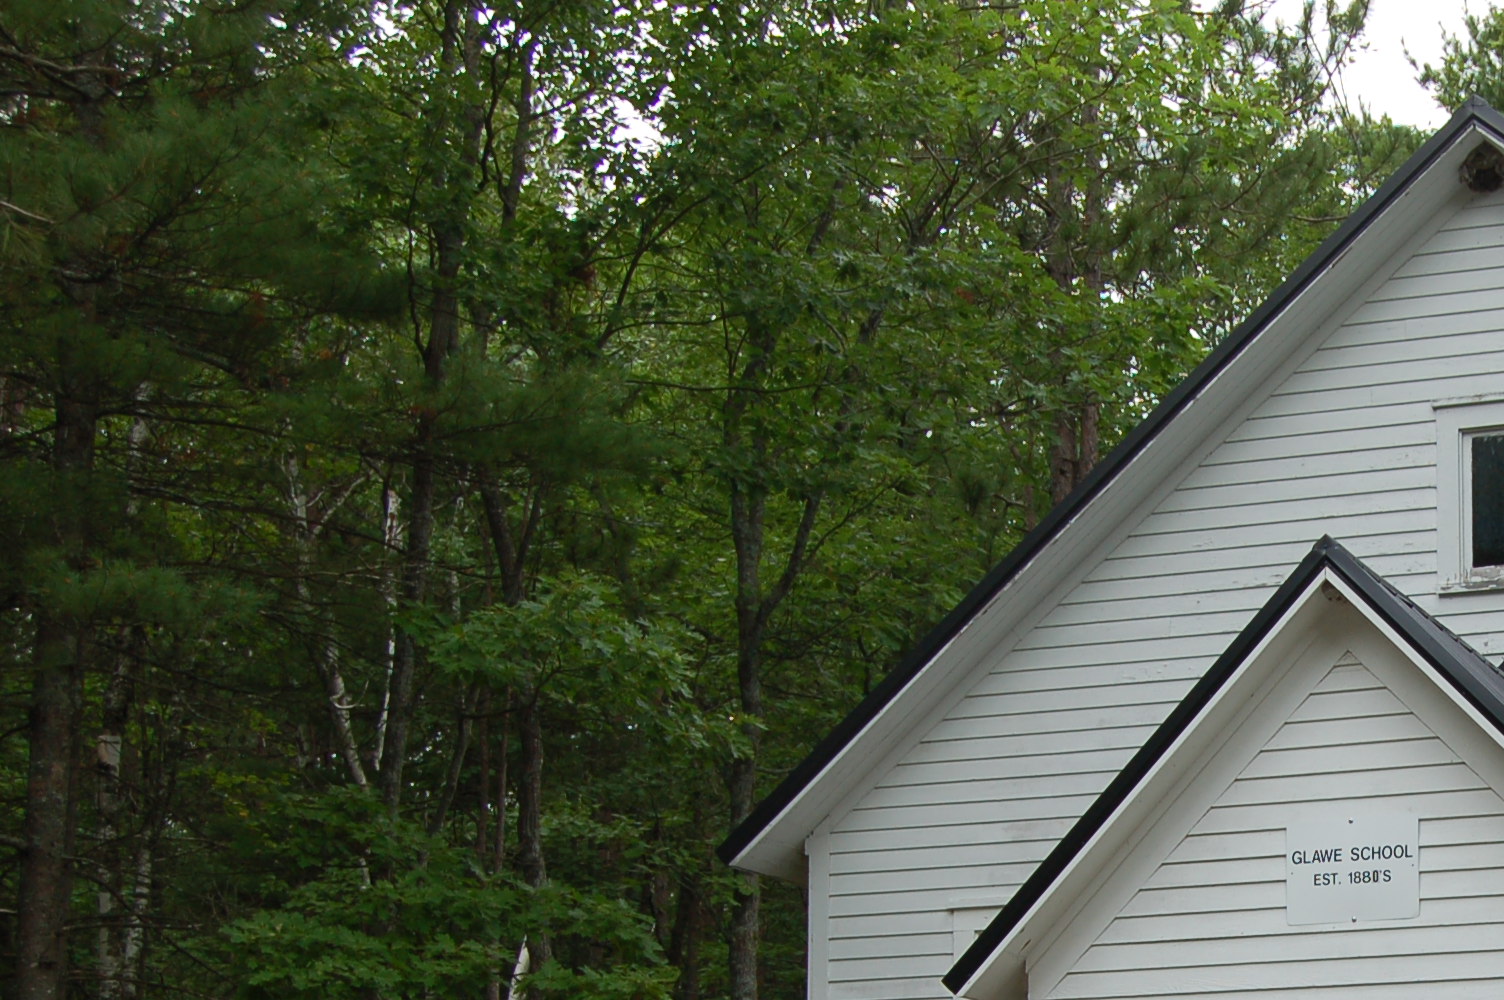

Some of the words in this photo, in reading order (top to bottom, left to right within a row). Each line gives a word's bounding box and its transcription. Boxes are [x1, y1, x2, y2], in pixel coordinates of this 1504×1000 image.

[1291, 848, 1343, 865] GLAWE
[1350, 844, 1413, 861] SCHOOL
[1313, 872, 1342, 886] EST.
[1347, 869, 1392, 884] 1880'S
